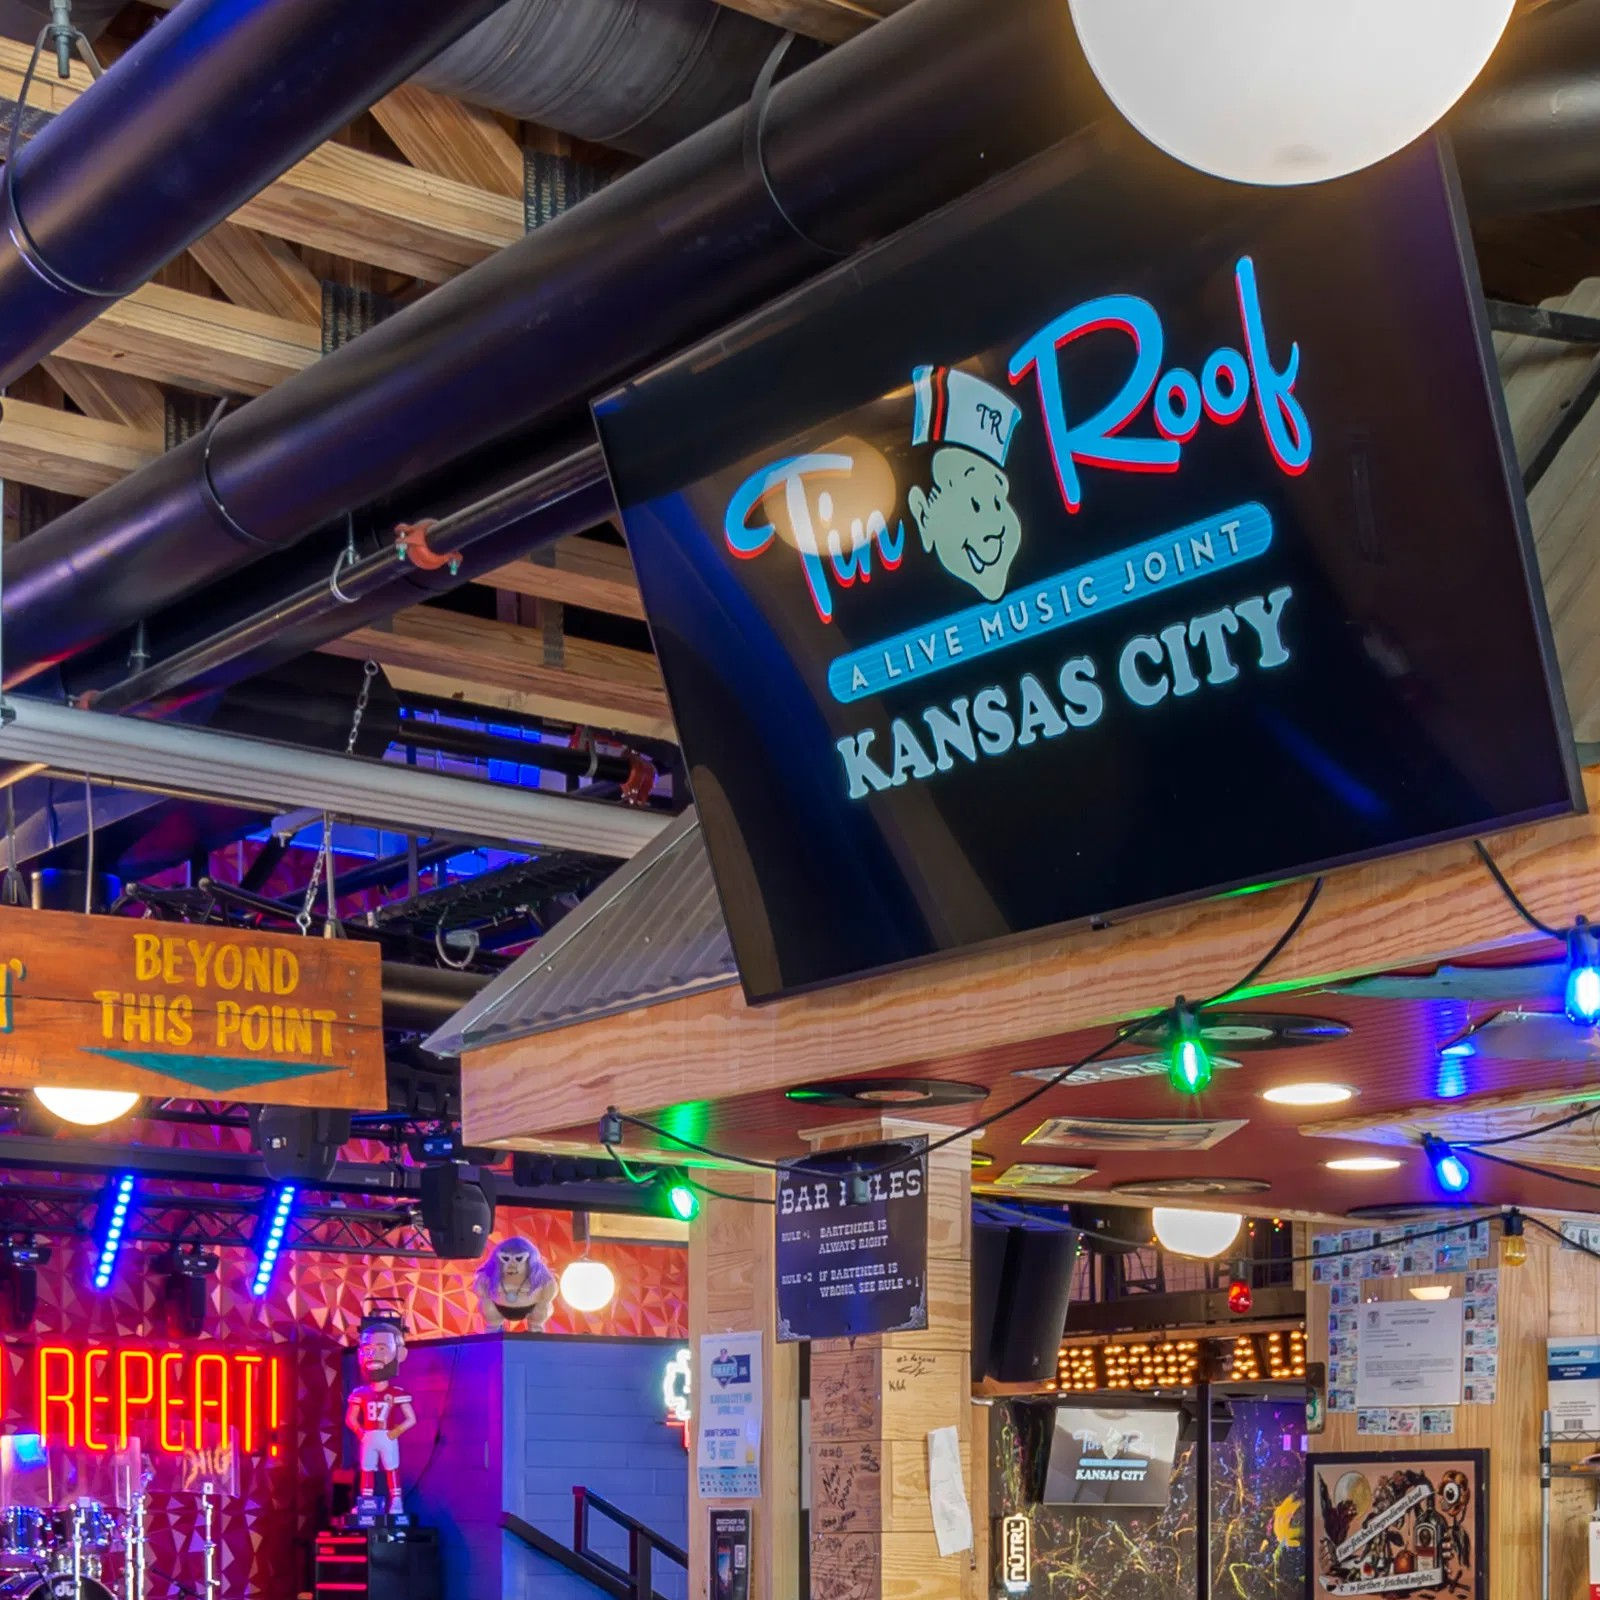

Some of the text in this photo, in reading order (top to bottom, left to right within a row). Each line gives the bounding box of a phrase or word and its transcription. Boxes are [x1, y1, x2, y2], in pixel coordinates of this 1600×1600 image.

[724, 255, 1313, 623] Tin Roof
[851, 519, 1242, 691] A LIVE MUSIC JOINT
[836, 586, 1293, 800] KANSAS CITY
[133, 933, 299, 995] BEYOND
[93, 989, 337, 1057] THIS POINT
[781, 1183, 830, 1215] BAR
[782, 1230, 801, 1242] RULE
[820, 1220, 875, 1238] BARTENDER
[878, 1219, 887, 1231] IS
[819, 1235, 889, 1255] ALWAYS RIGHT
[782, 1273, 802, 1285] RULE
[819, 1270, 829, 1282] IF
[831, 1263, 886, 1280] BARTENDER
[888, 1262, 899, 1274] IS
[859, 1281, 877, 1293] SEE
[878, 1277, 904, 1290] RULE
[37, 1344, 282, 1455] REPEAT!
[367, 1401, 389, 1421] 87
[1075, 1469, 1148, 1481] KANSAS CITY
